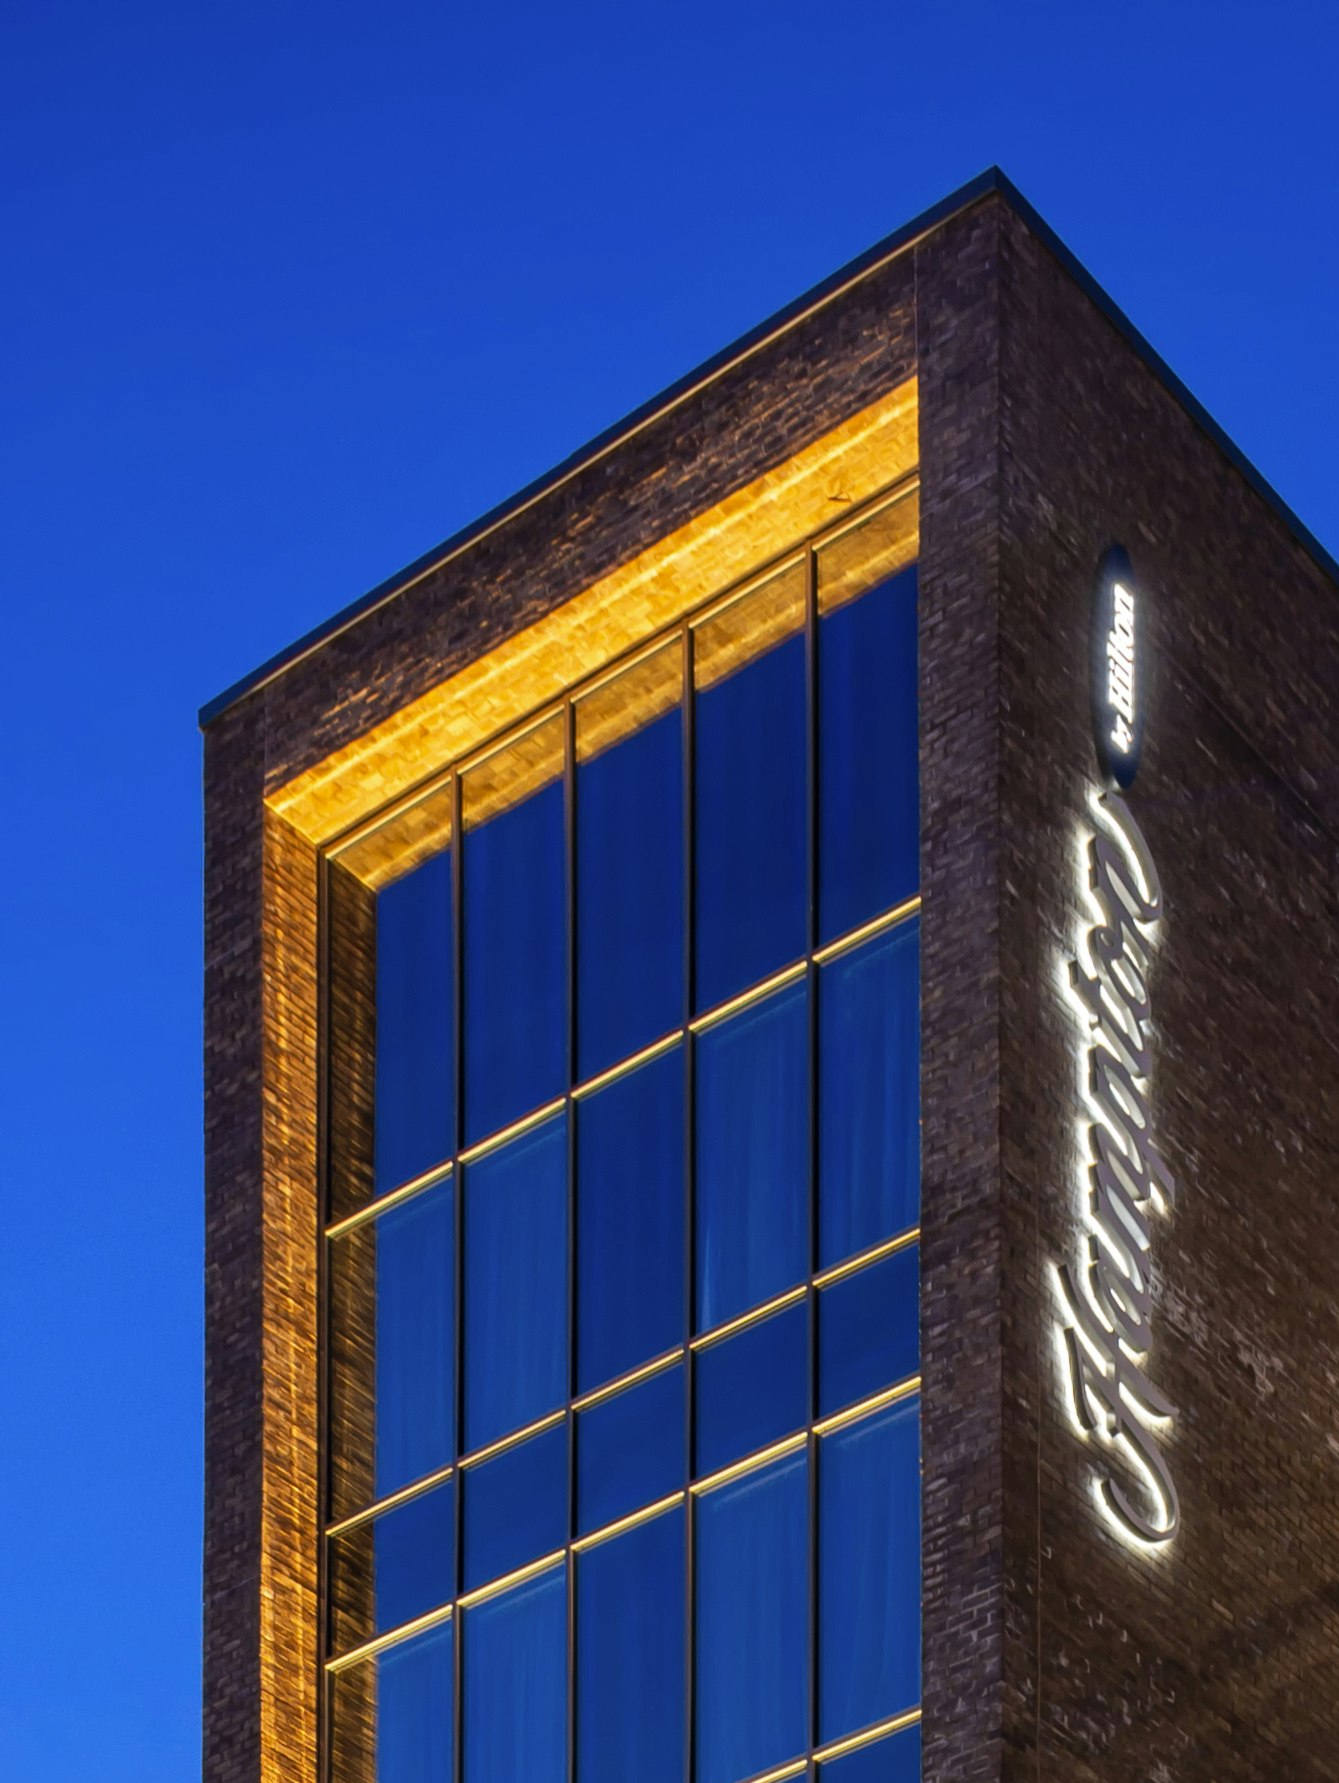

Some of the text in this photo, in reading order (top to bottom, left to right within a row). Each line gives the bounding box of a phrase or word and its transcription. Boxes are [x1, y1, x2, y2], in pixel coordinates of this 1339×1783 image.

[1107, 583, 1135, 754] by Hilton
[1052, 790, 1181, 1542] Hampton
